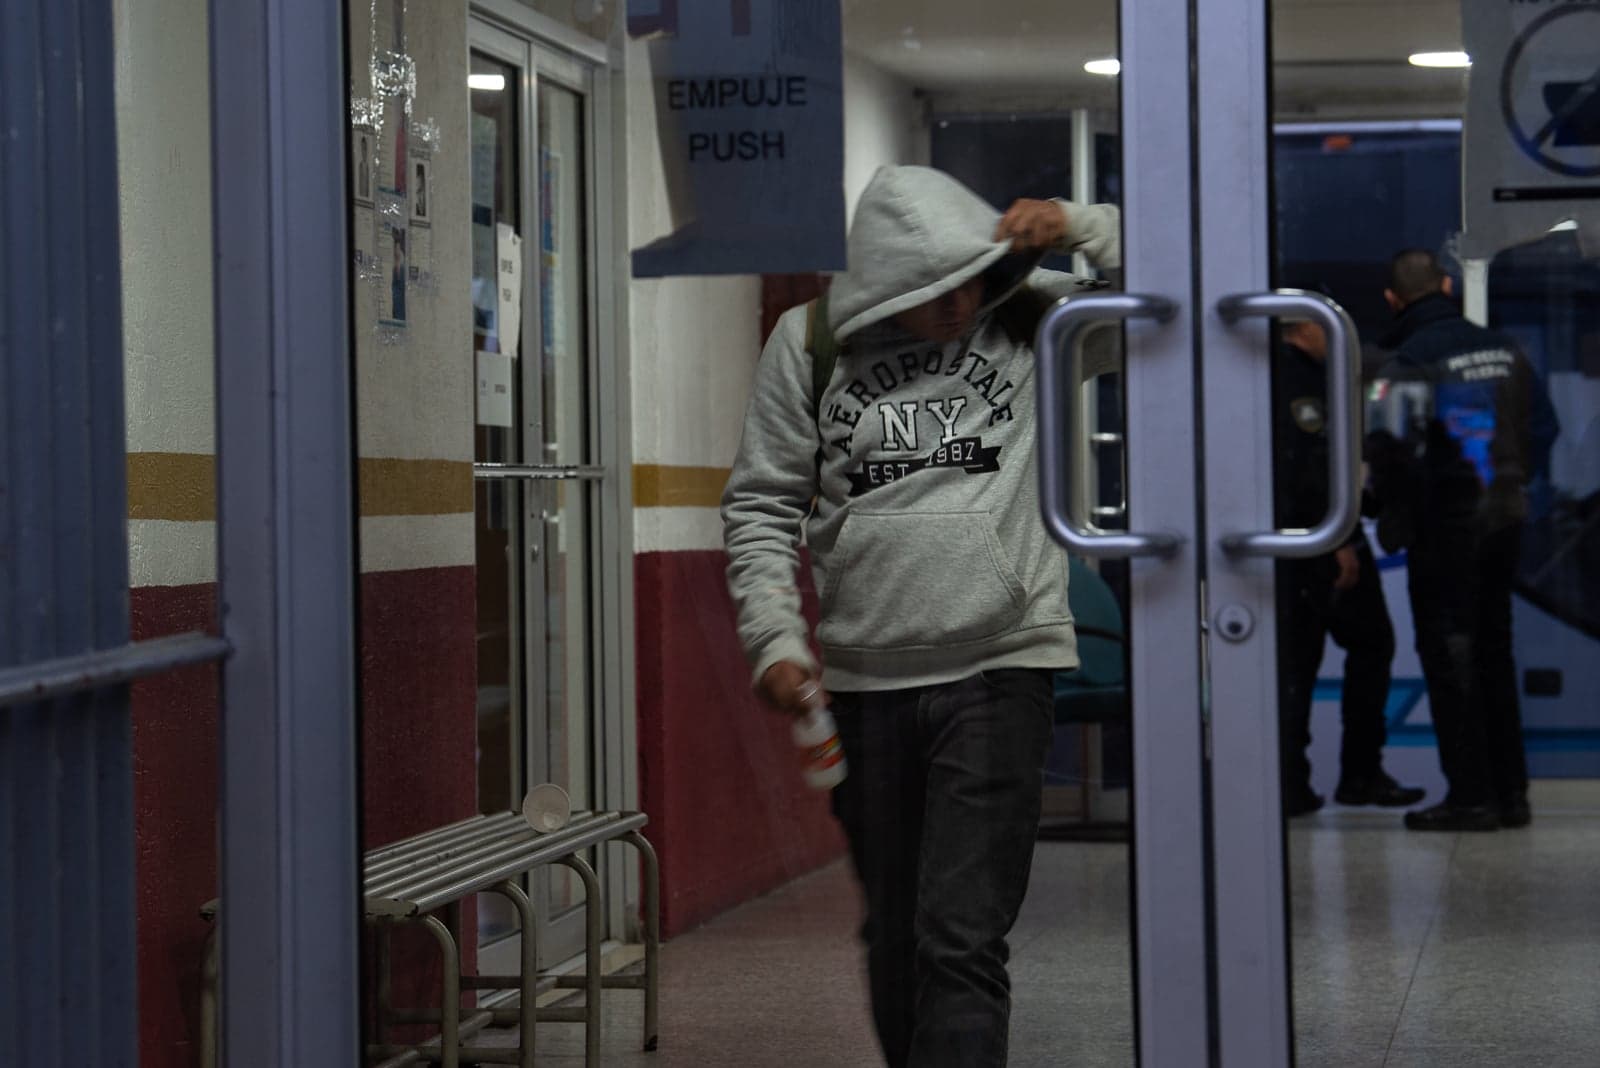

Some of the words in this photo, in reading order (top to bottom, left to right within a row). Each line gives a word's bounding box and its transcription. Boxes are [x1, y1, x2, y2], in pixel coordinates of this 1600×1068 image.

[667, 76, 808, 110] EMPUJE
[688, 131, 785, 161] PUSH
[879, 396, 967, 450] NY
[868, 463, 910, 484] EST
[925, 441, 976, 467] 1987
